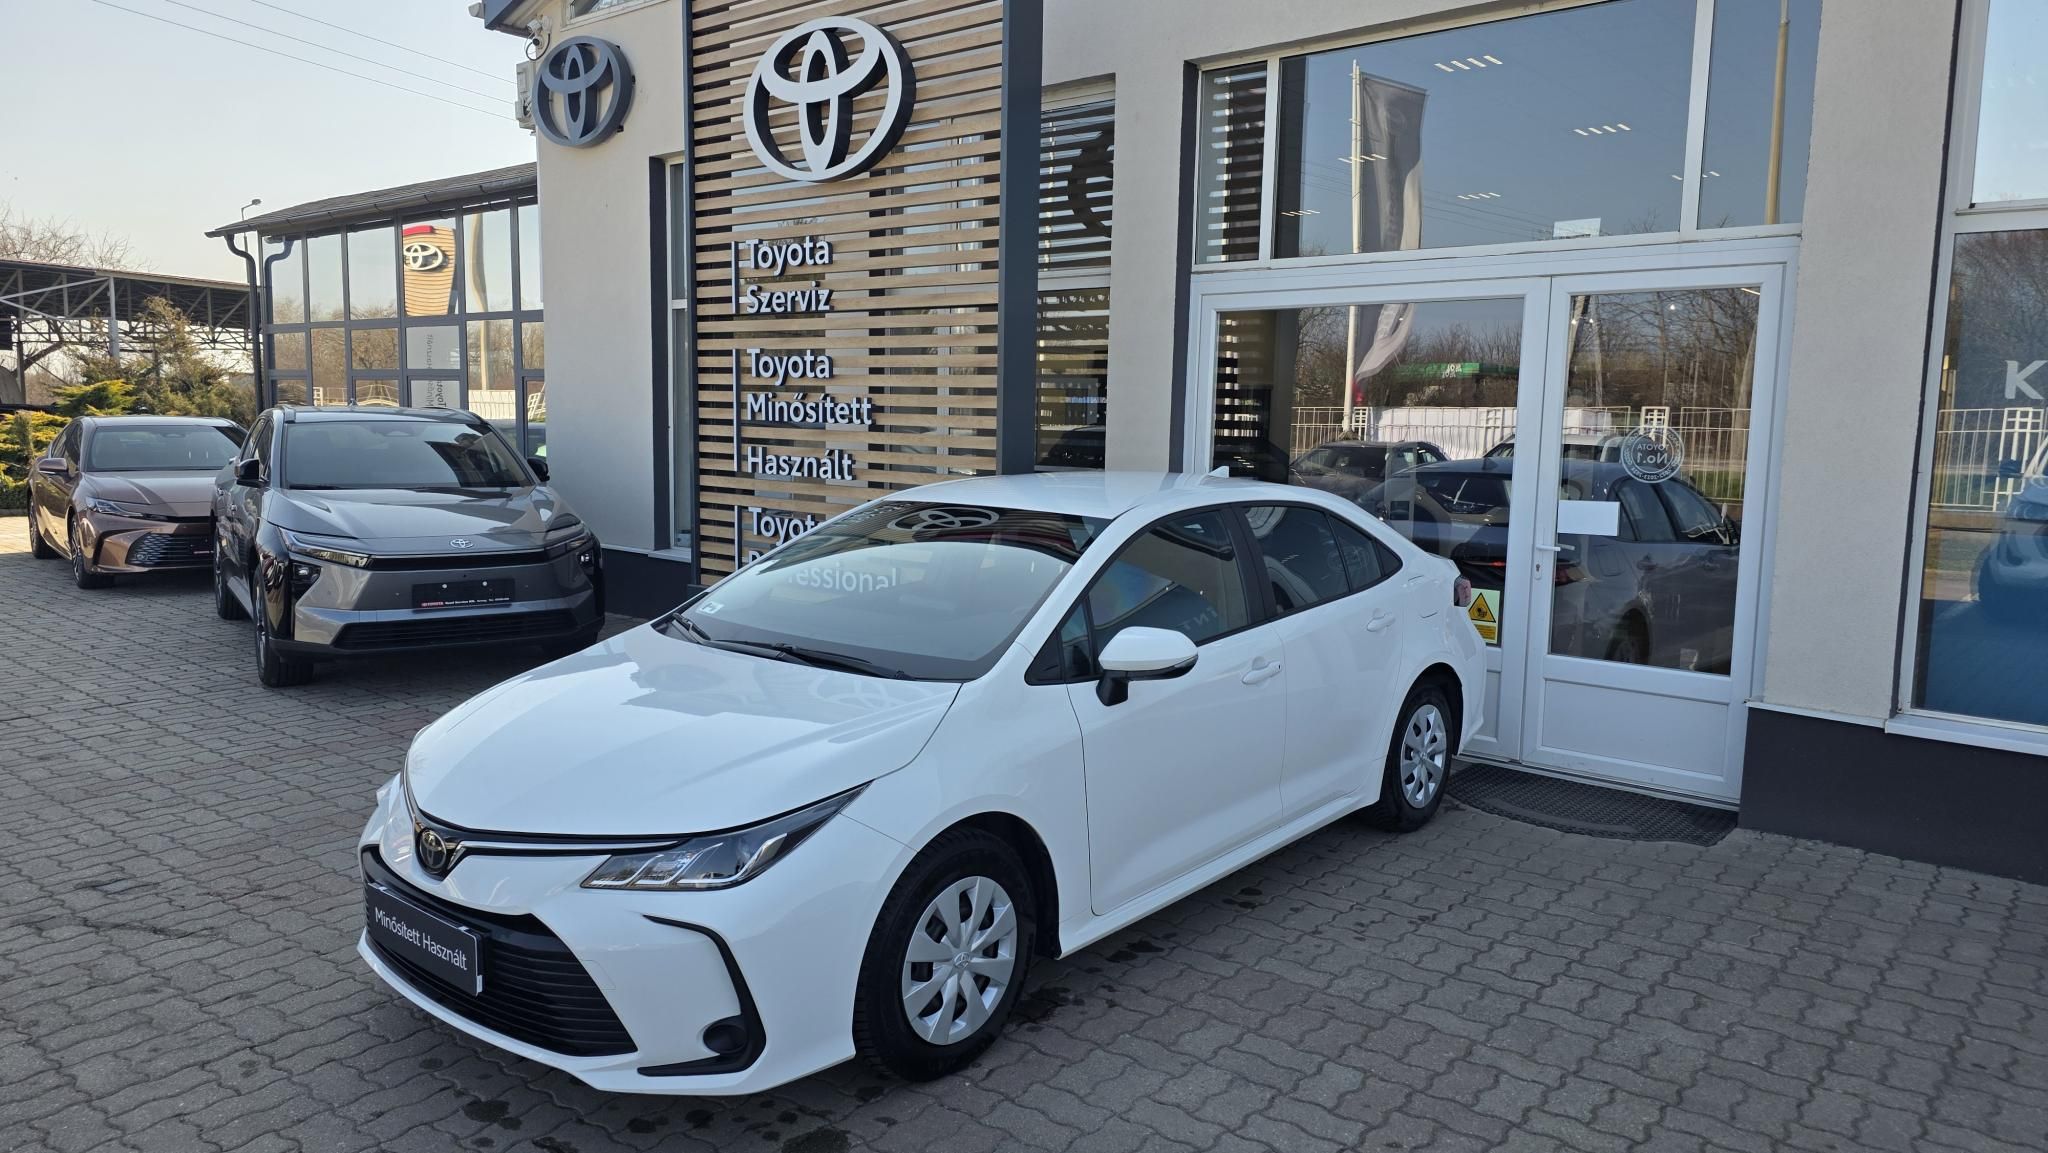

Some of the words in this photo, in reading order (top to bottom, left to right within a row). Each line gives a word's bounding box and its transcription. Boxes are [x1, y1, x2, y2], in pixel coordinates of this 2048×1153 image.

[746, 236, 831, 276] Toyota
[746, 280, 831, 313] Szerviz
[747, 348, 832, 386] Toyota
[747, 393, 873, 425] Minősített
[747, 446, 855, 480] Használt
[748, 506, 820, 547] Toyot
[375, 906, 421, 947] Minősített
[422, 932, 468, 971] Használt
